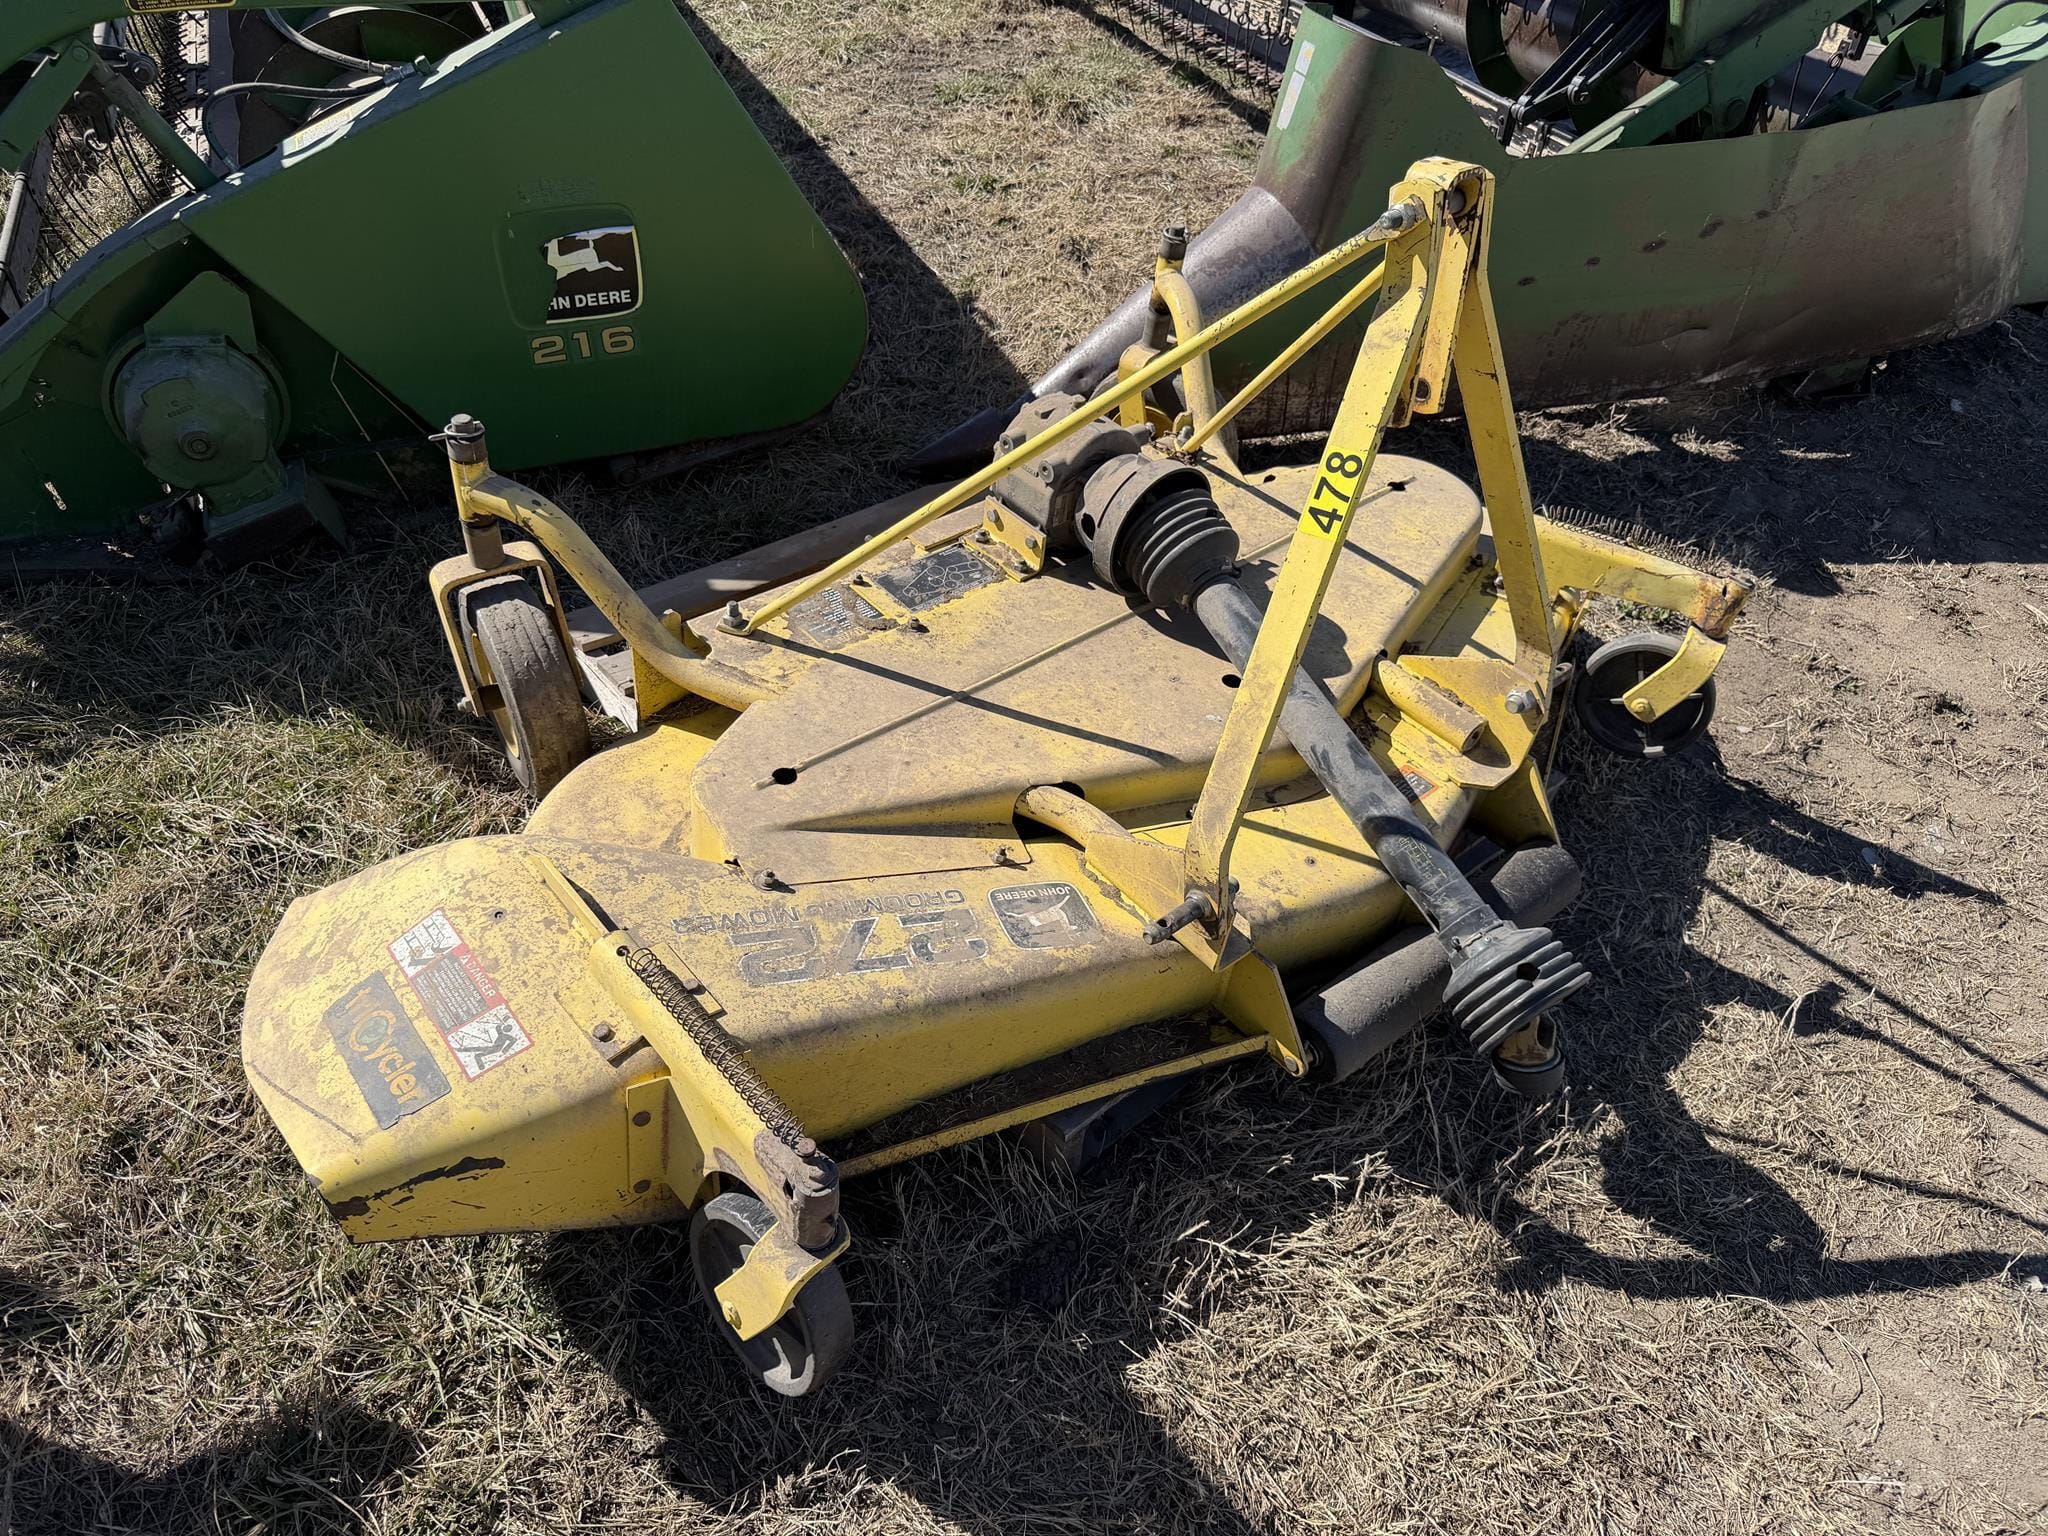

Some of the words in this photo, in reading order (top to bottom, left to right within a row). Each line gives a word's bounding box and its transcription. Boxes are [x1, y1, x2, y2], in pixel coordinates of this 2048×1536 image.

[548, 296, 571, 310] HN
[575, 290, 632, 308] DEERE
[531, 325, 635, 366] 216
[1307, 451, 1363, 535] 478
[994, 889, 1038, 902] DEERE
[1037, 886, 1071, 898] JOHN
[670, 905, 801, 935] MOWER
[728, 908, 988, 988] 272
[466, 961, 495, 999] DANGER
